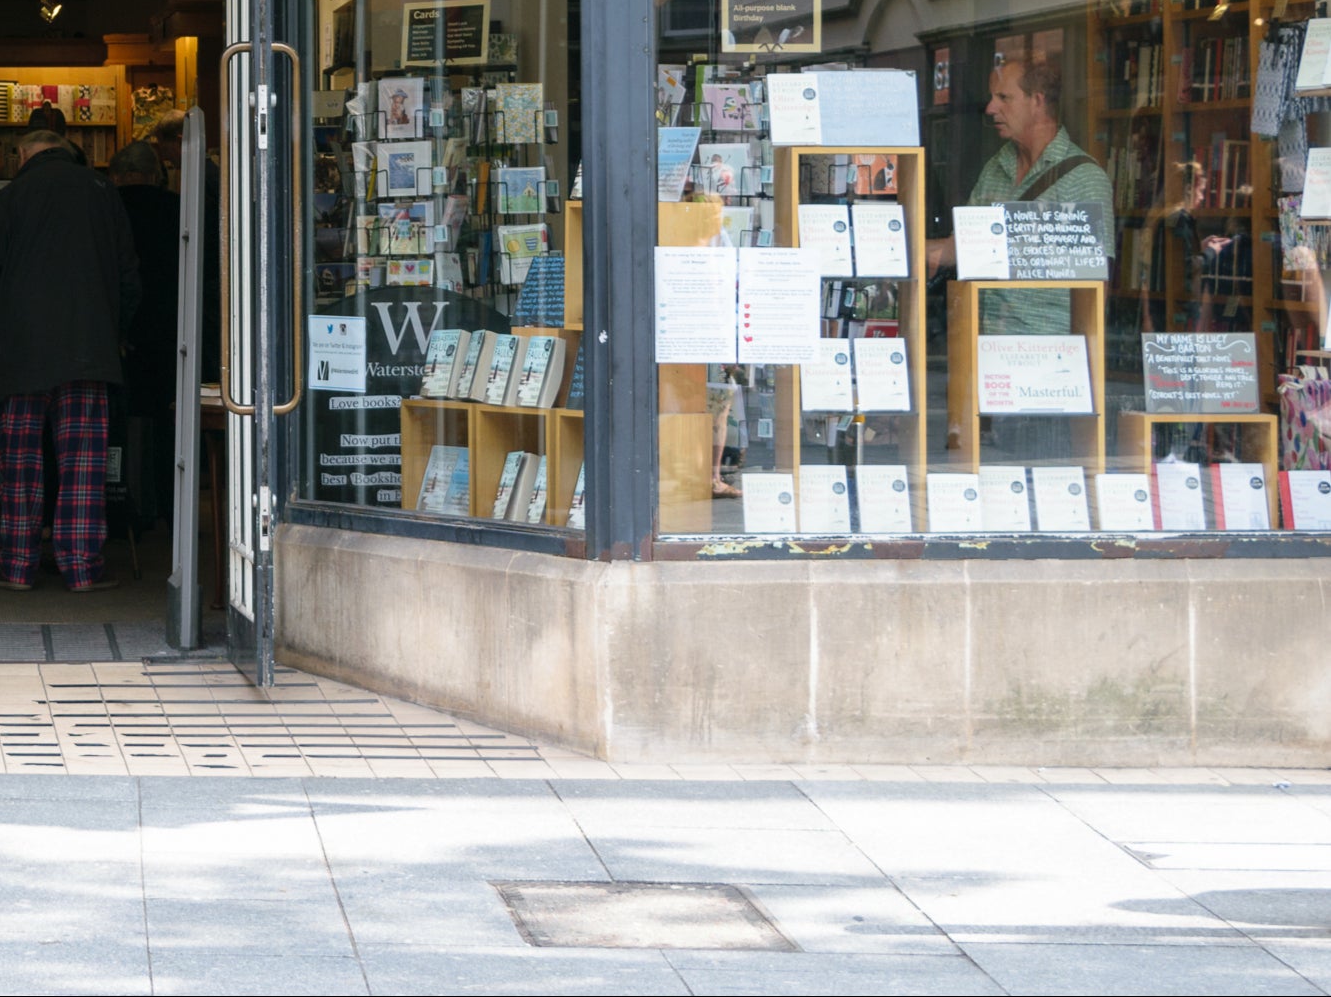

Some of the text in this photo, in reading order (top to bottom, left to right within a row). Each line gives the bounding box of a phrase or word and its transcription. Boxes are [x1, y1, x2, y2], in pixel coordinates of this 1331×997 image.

[733, 4, 775, 13] All-purpose
[414, 10, 440, 20] Cards
[733, 14, 764, 23] Birthday
[1016, 269, 1044, 279] ALICE
[371, 301, 450, 356] W
[1156, 334, 1168, 343] MY
[1171, 334, 1191, 343] NAME
[1196, 334, 1204, 343] IS
[981, 341, 1079, 356] Olive Kitteridge
[1177, 344, 1212, 353] BARTON
[331, 397, 401, 409] Love books?
[342, 435, 391, 448] Now put
[322, 454, 367, 465] because
[370, 456, 386, 464] we
[322, 473, 346, 484] best
[379, 490, 390, 500] in
